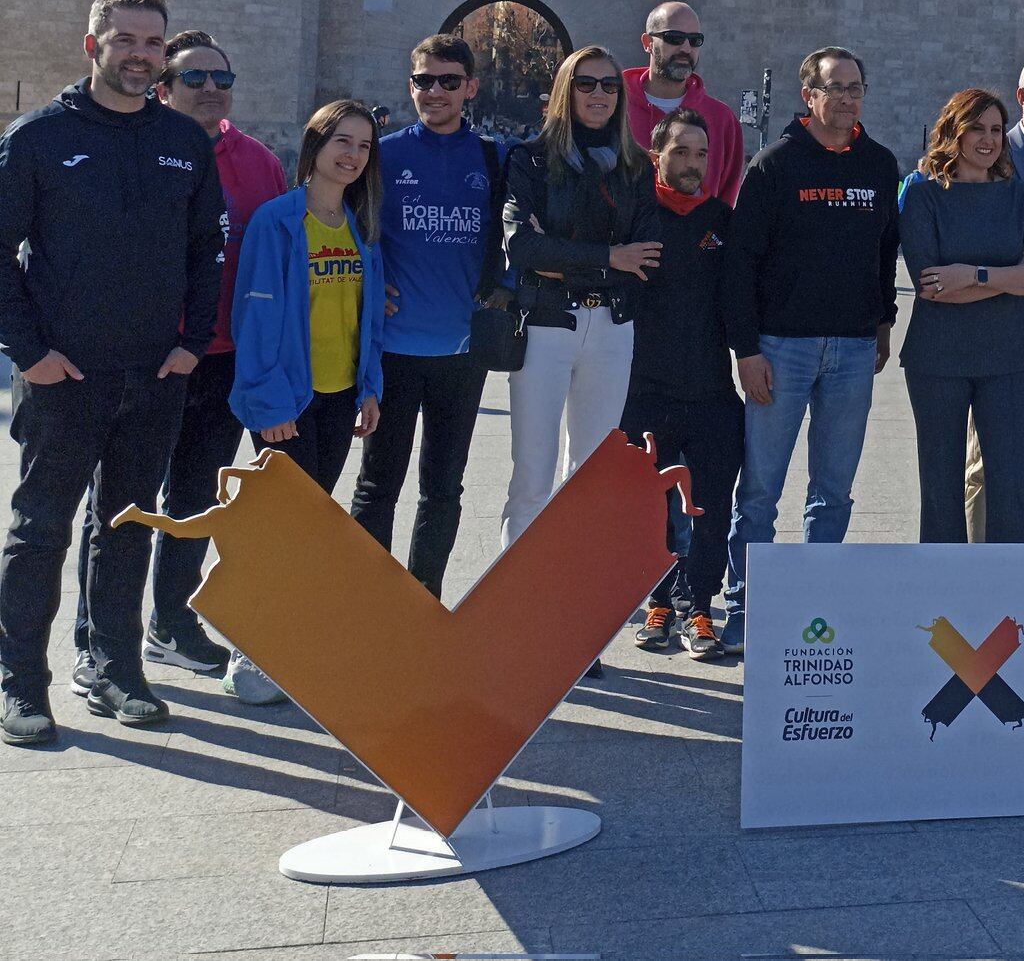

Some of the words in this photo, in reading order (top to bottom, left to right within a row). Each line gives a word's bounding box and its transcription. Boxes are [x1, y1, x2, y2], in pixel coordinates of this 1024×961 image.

[158, 156, 193, 171] SANUS
[799, 188, 844, 201] NEVER
[846, 188, 875, 201] STOP
[402, 205, 481, 220] POBLATS
[402, 218, 481, 232] MARITIMS
[424, 229, 478, 244] Valencia
[784, 647, 853, 657] FUNDACIÓN
[783, 658, 854, 672] TRINIDAD
[783, 672, 854, 686] ALFONSO
[784, 707, 840, 724] Cultura
[840, 713, 854, 722] del
[782, 723, 854, 741] Esfuerzo
